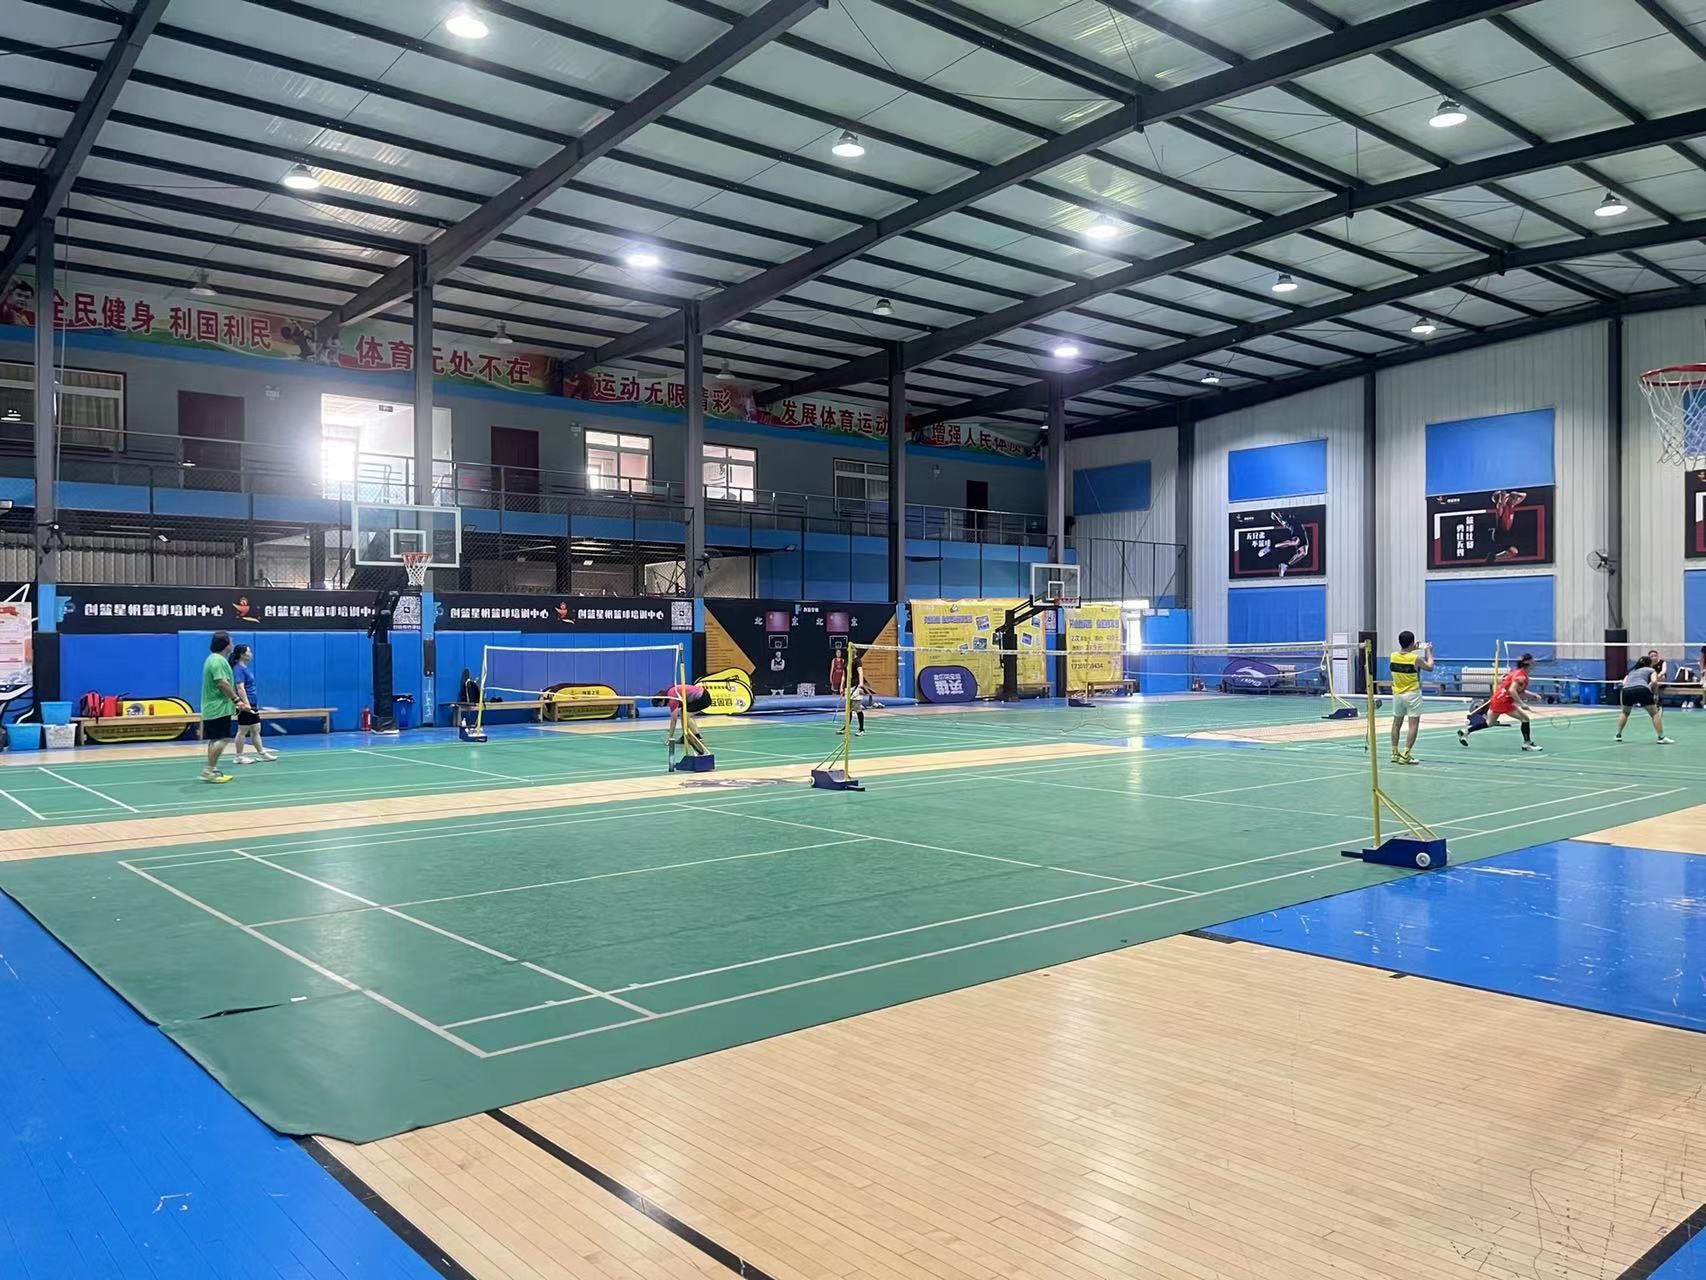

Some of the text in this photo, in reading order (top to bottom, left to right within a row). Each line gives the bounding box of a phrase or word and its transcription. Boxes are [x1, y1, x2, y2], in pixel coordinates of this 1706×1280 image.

[169, 306, 272, 350] 利国利民
[265, 605, 375, 618] 创篮星帆篮球培训中
